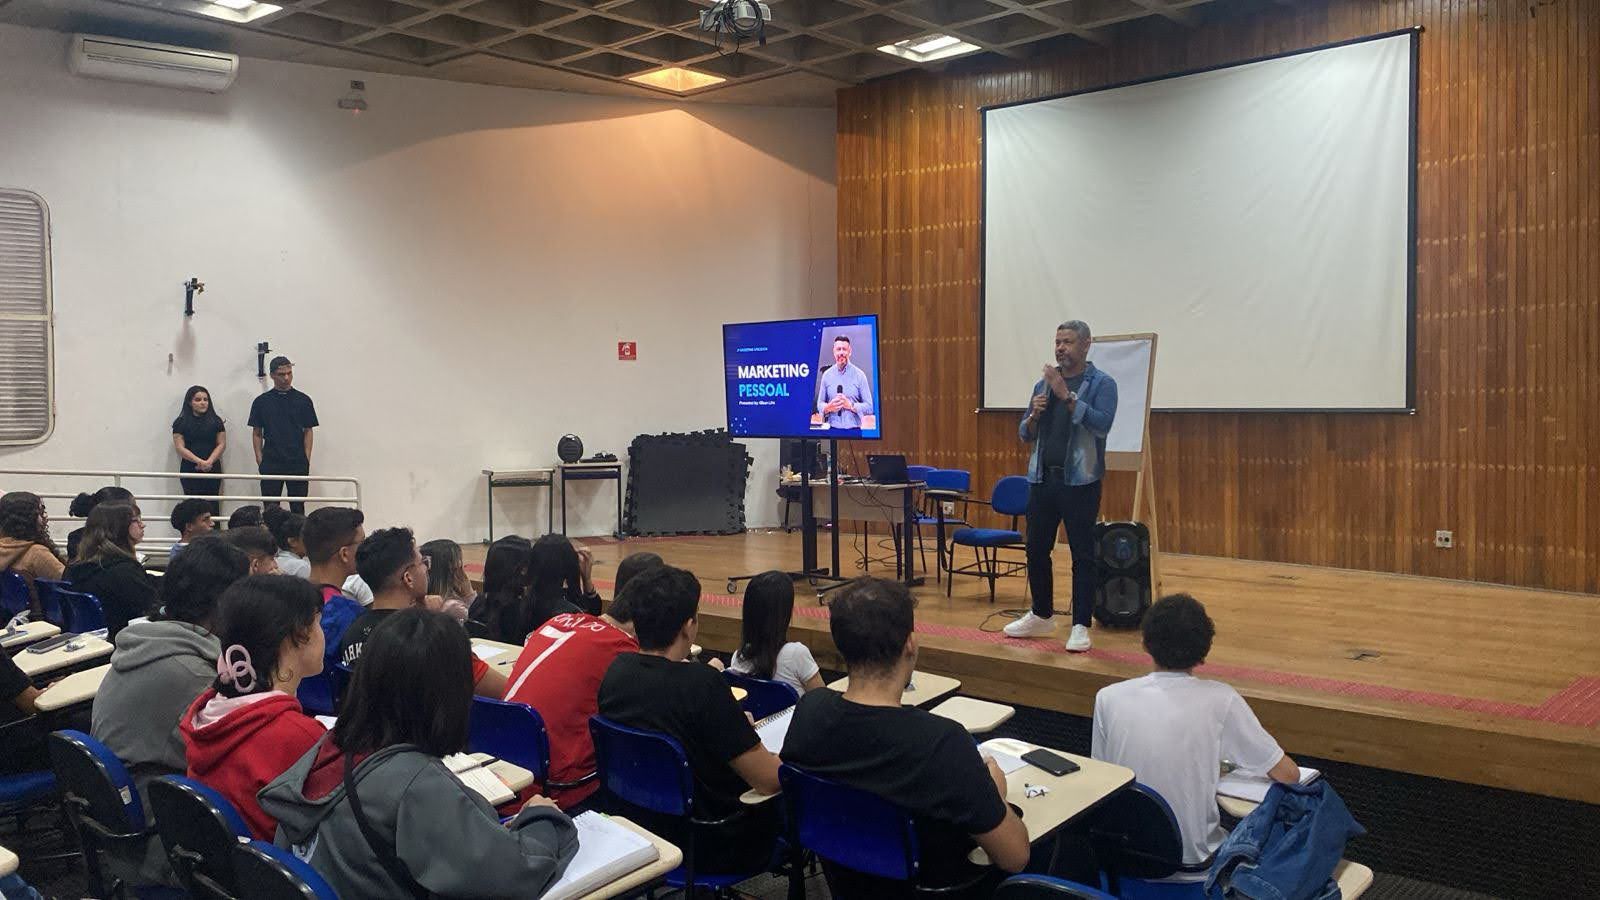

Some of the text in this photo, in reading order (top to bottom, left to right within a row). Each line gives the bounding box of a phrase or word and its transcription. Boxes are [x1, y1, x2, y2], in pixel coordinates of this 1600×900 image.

[738, 363, 810, 379] MARKETING
[739, 383, 790, 397] PESSOAL
[504, 625, 577, 701] 7
